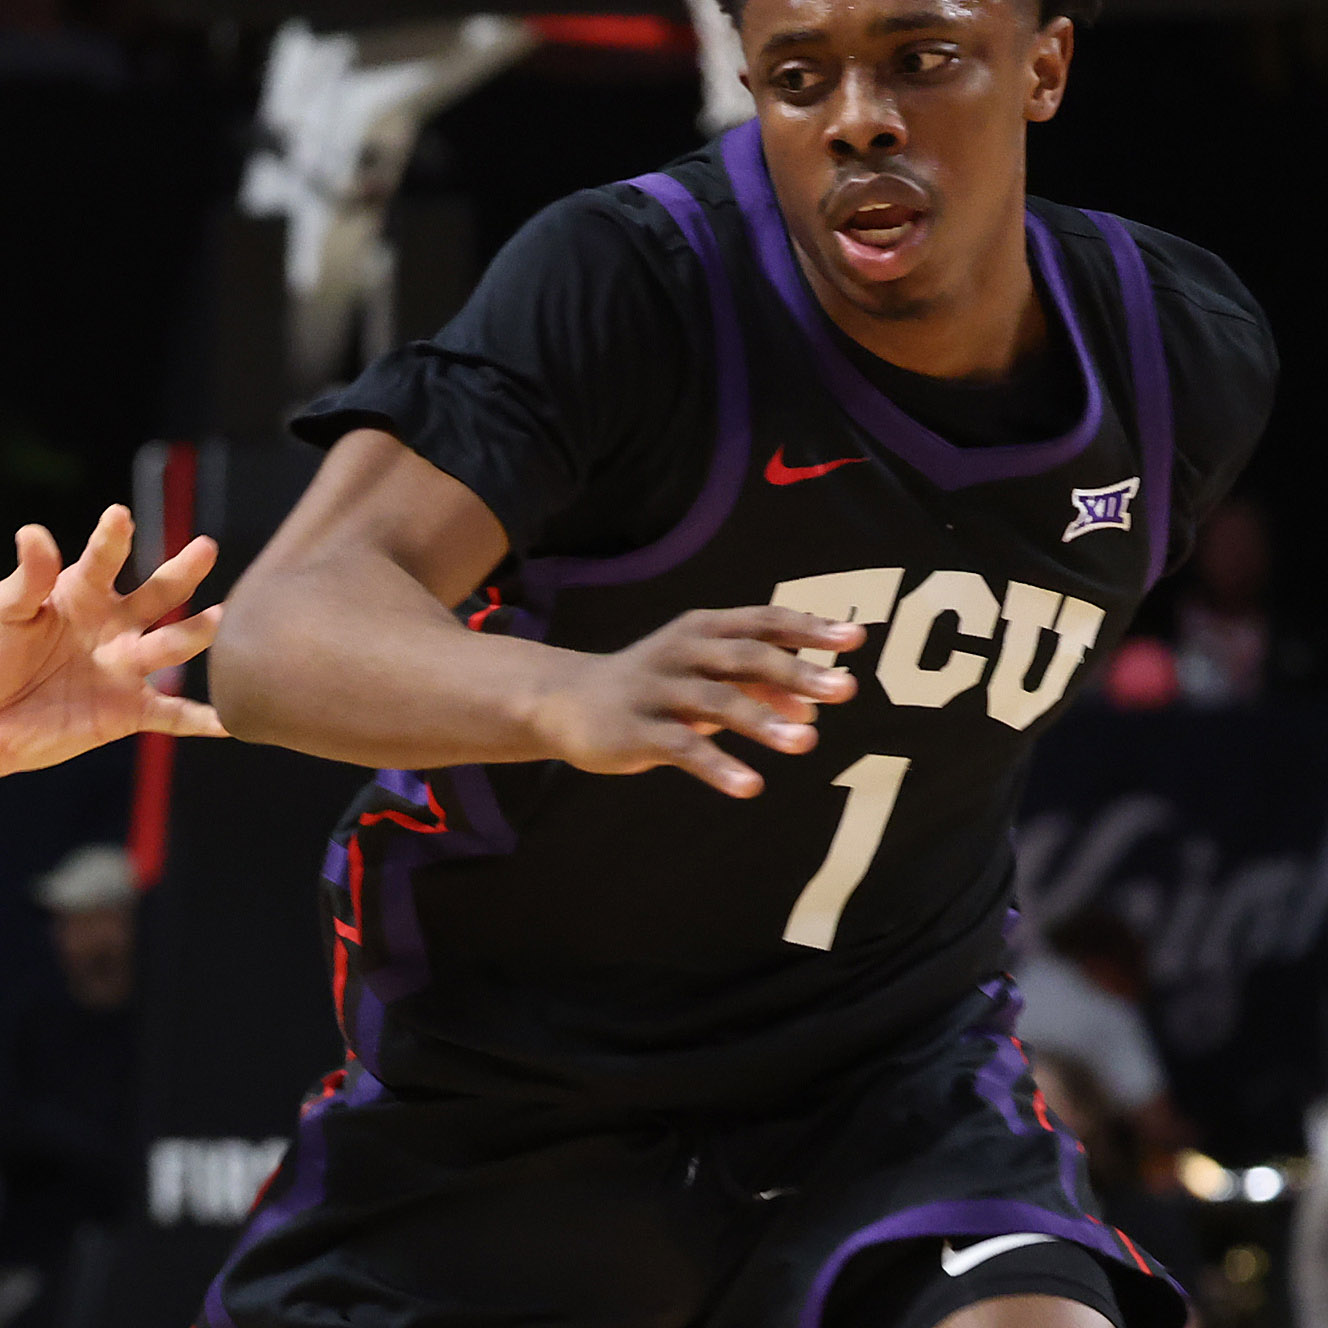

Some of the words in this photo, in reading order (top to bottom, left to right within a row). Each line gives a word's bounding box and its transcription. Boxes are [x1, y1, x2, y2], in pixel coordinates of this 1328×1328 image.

[1068, 481, 1135, 535] XII
[769, 567, 1106, 731] TCU
[782, 754, 911, 950] 1
